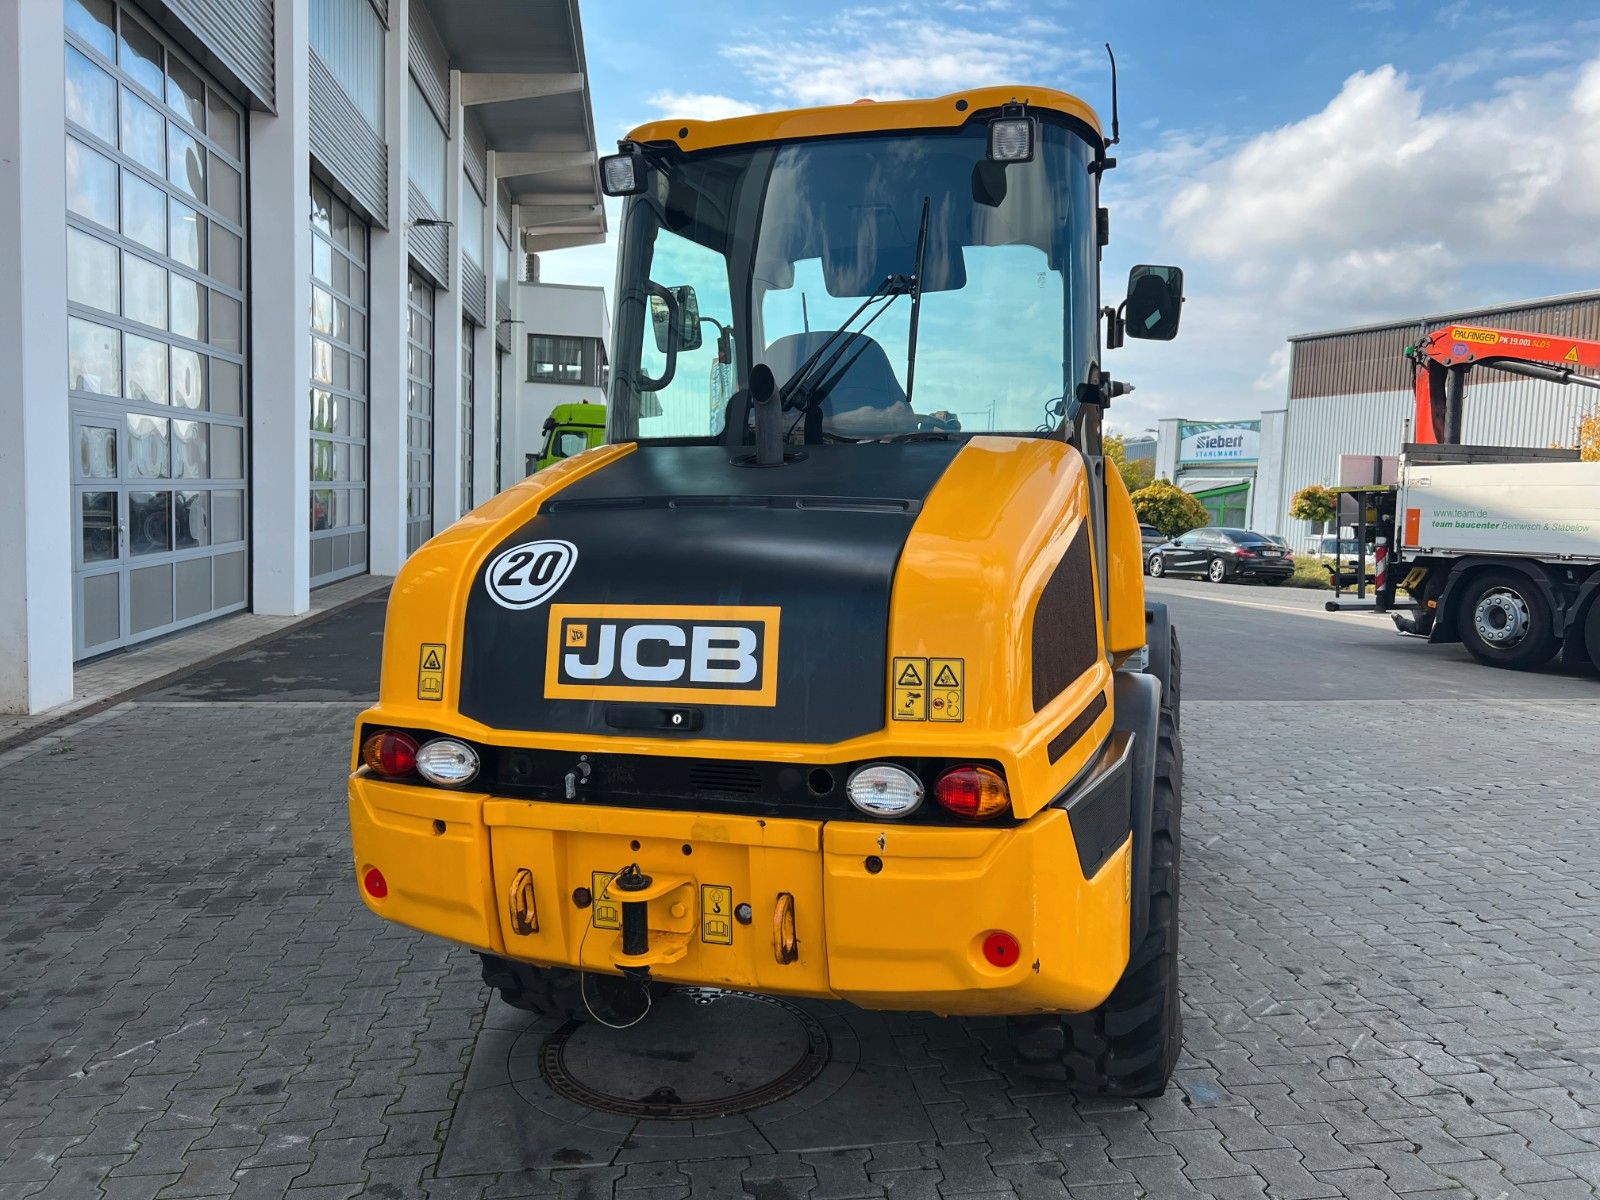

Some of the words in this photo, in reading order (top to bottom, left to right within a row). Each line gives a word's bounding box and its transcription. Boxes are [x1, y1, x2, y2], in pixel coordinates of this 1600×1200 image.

[1453, 329, 1496, 343] PALFINGER
[1499, 336, 1508, 344] PK
[1509, 337, 1531, 346] 19.001
[1196, 434, 1243, 448] Siebert
[1433, 509, 1488, 518] www.team.de
[1431, 520, 1453, 528] team
[1454, 520, 1500, 530] baucenter
[1501, 521, 1541, 531] Bentwisch
[497, 551, 563, 587] 20
[564, 624, 758, 683] JCB
